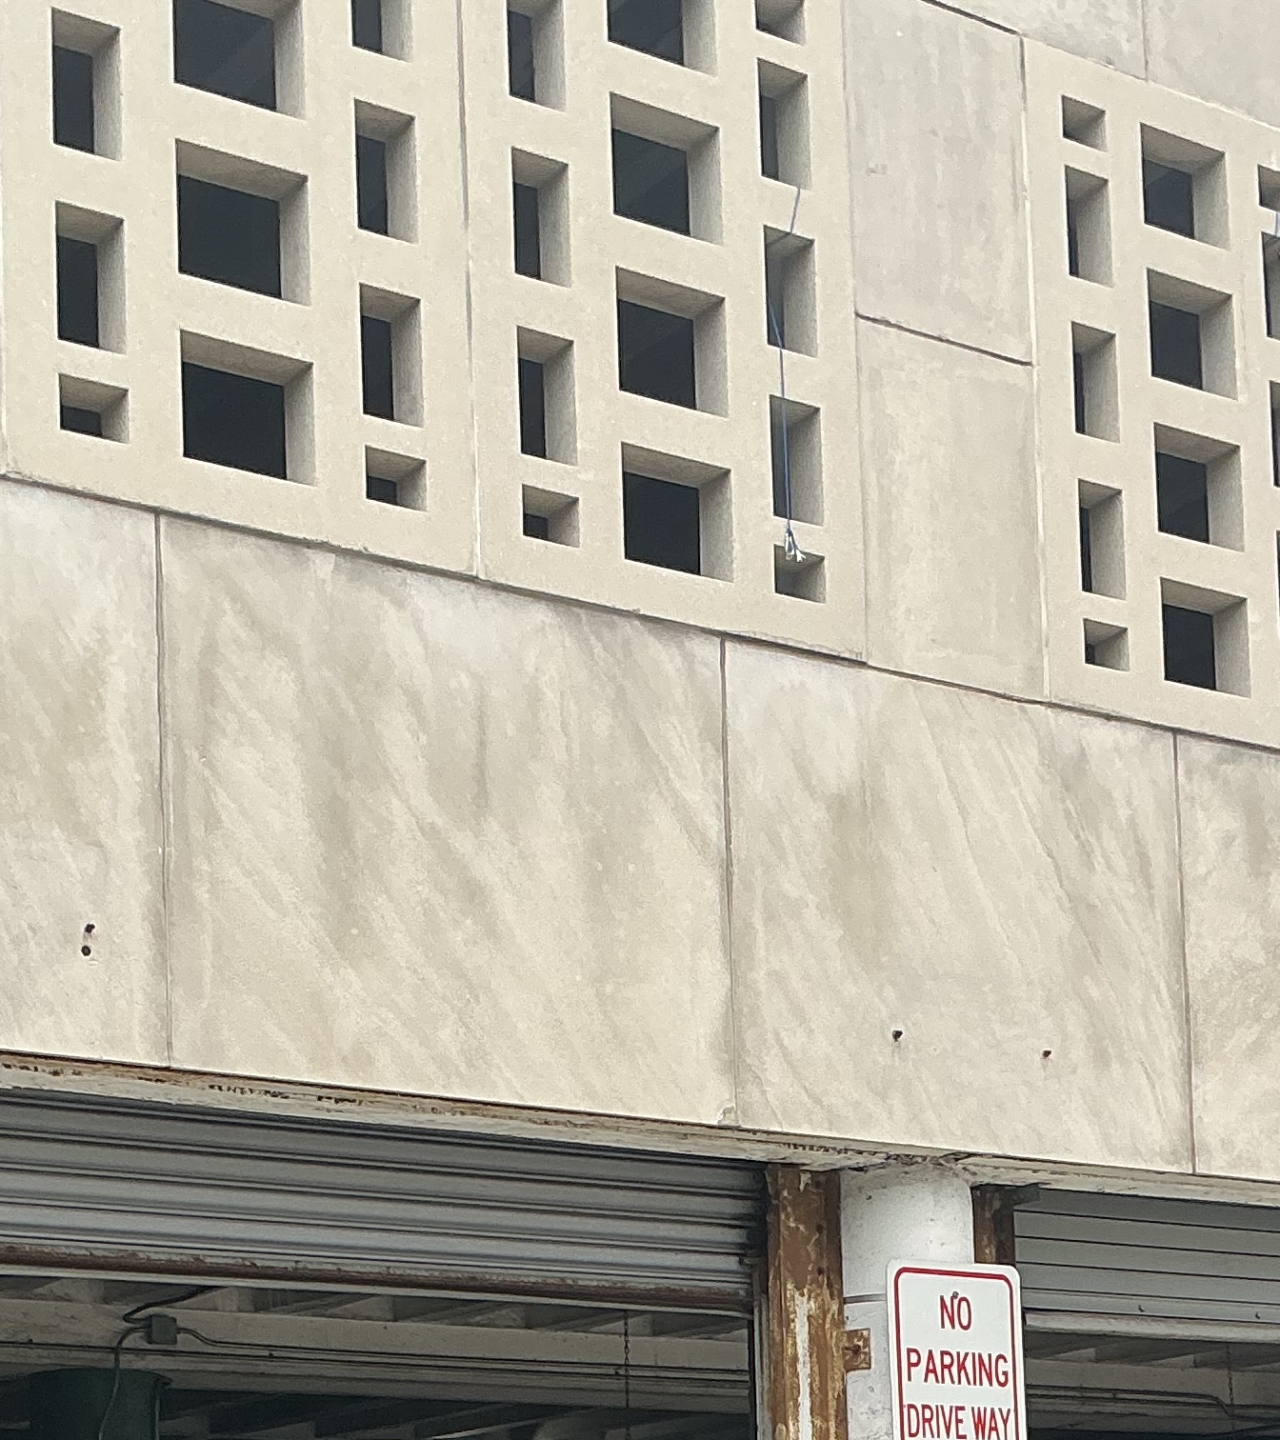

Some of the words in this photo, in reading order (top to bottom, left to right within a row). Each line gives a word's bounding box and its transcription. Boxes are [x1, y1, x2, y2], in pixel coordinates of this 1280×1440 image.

[940, 1294, 972, 1331] NO
[906, 1347, 1009, 1387] PARKING
[906, 1403, 967, 1440] DRIVE
[971, 1406, 1010, 1440] WAY
